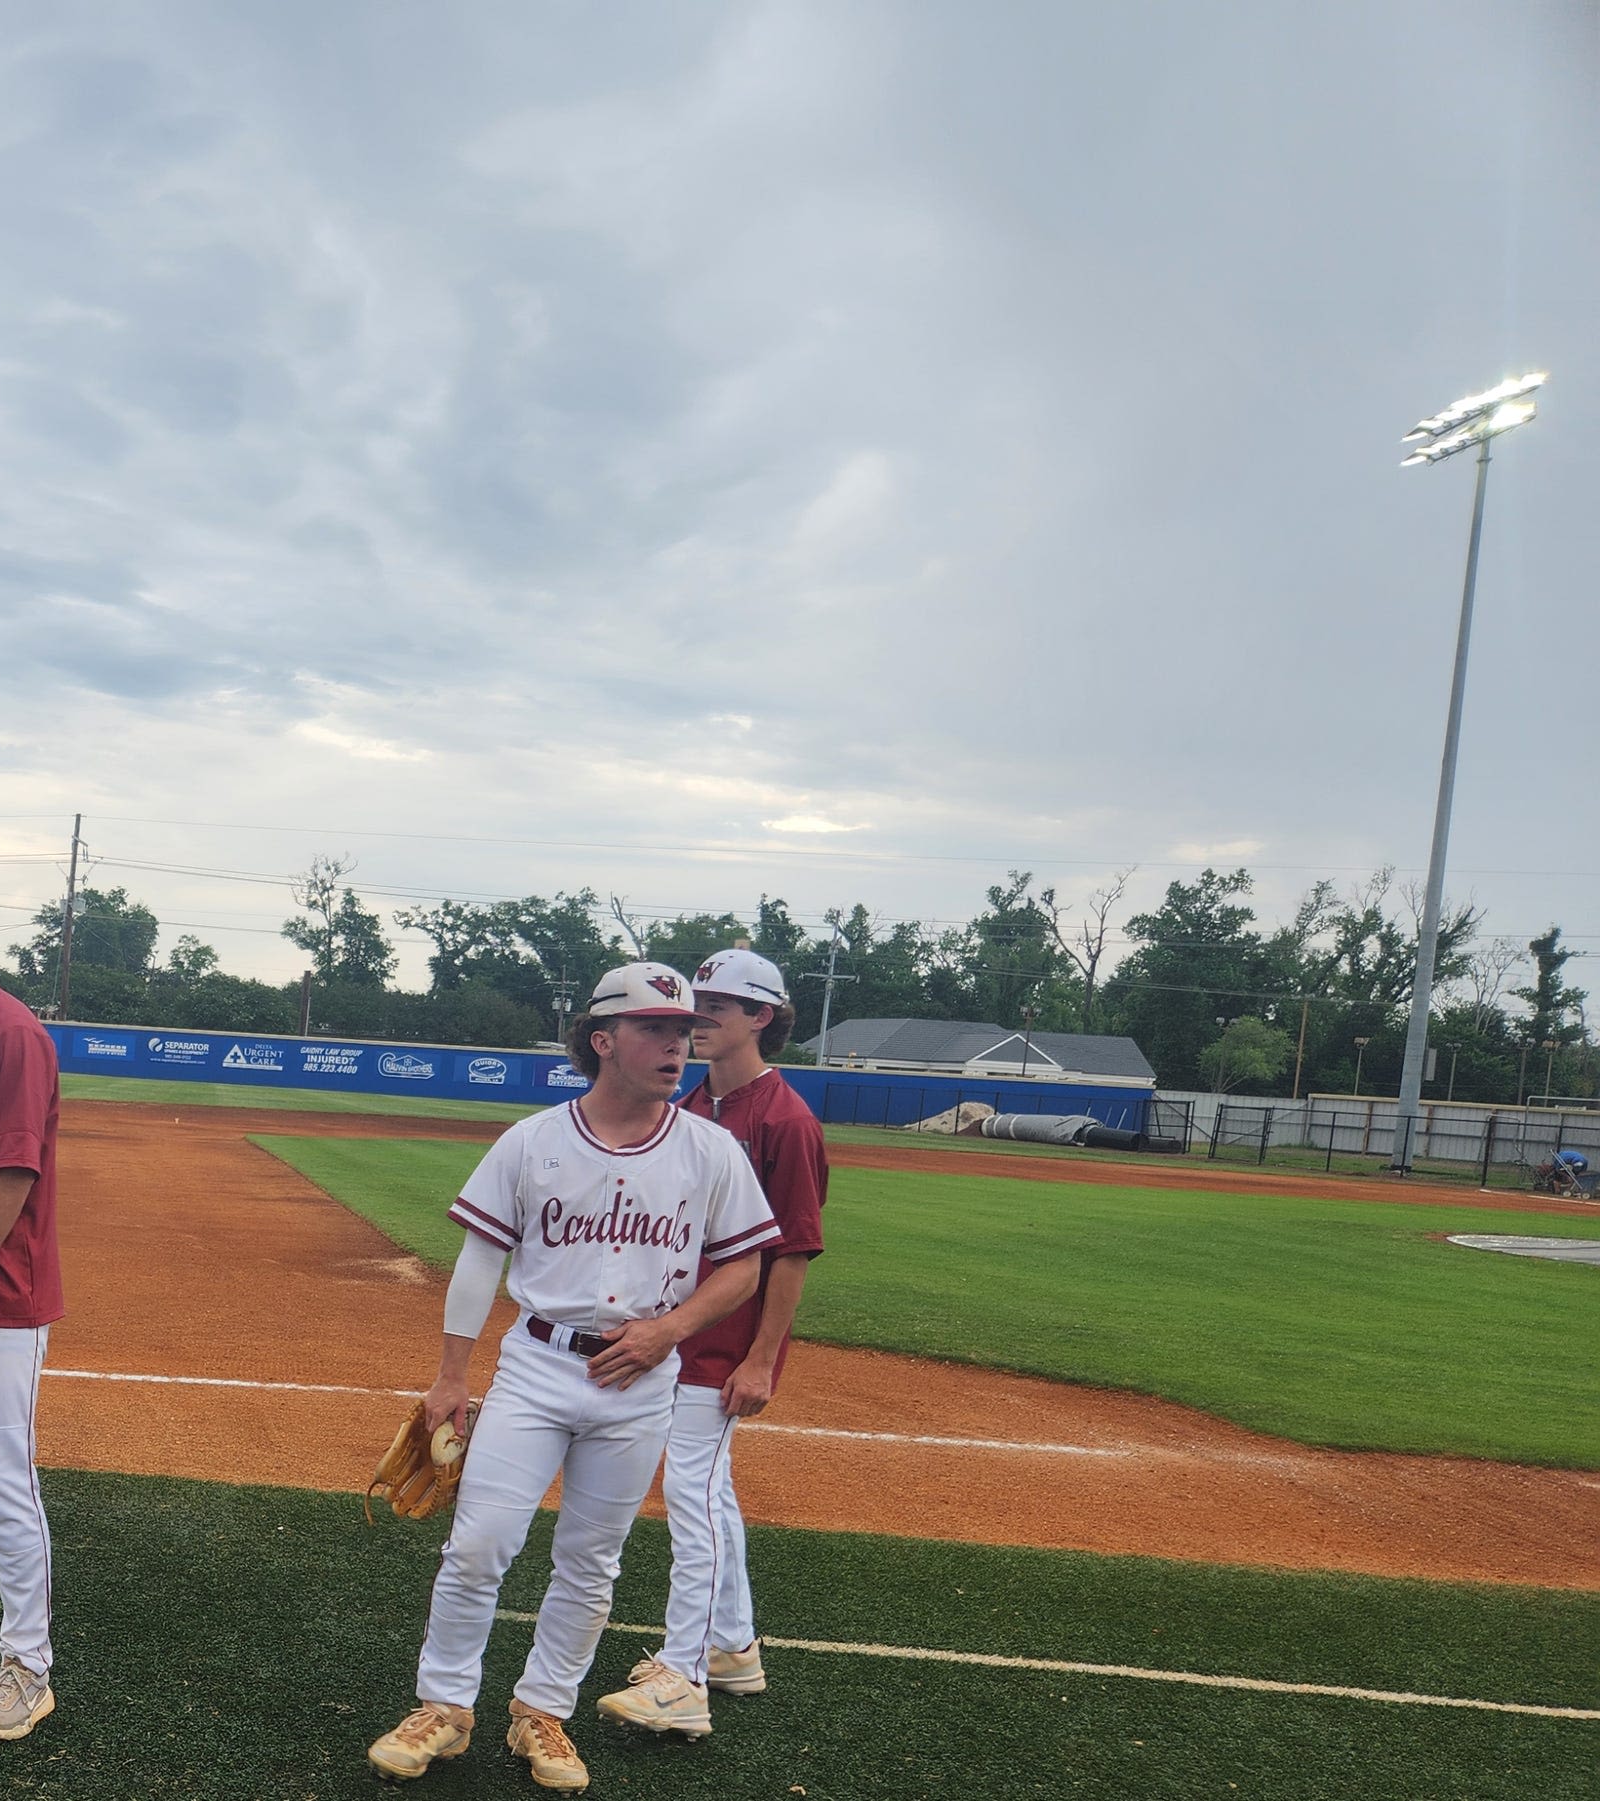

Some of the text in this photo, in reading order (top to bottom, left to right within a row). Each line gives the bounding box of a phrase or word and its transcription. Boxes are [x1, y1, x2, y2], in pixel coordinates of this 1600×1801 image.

[164, 1041, 210, 1052] SEPARATOR
[244, 1047, 285, 1058] URGENT
[325, 1048, 341, 1056] LAW
[340, 1049, 364, 1057] GROUP
[250, 1056, 276, 1066] CARE
[307, 1055, 355, 1065] INJURED?
[302, 1063, 358, 1074] 985.223.4400
[541, 1191, 691, 1253] Cardinals
